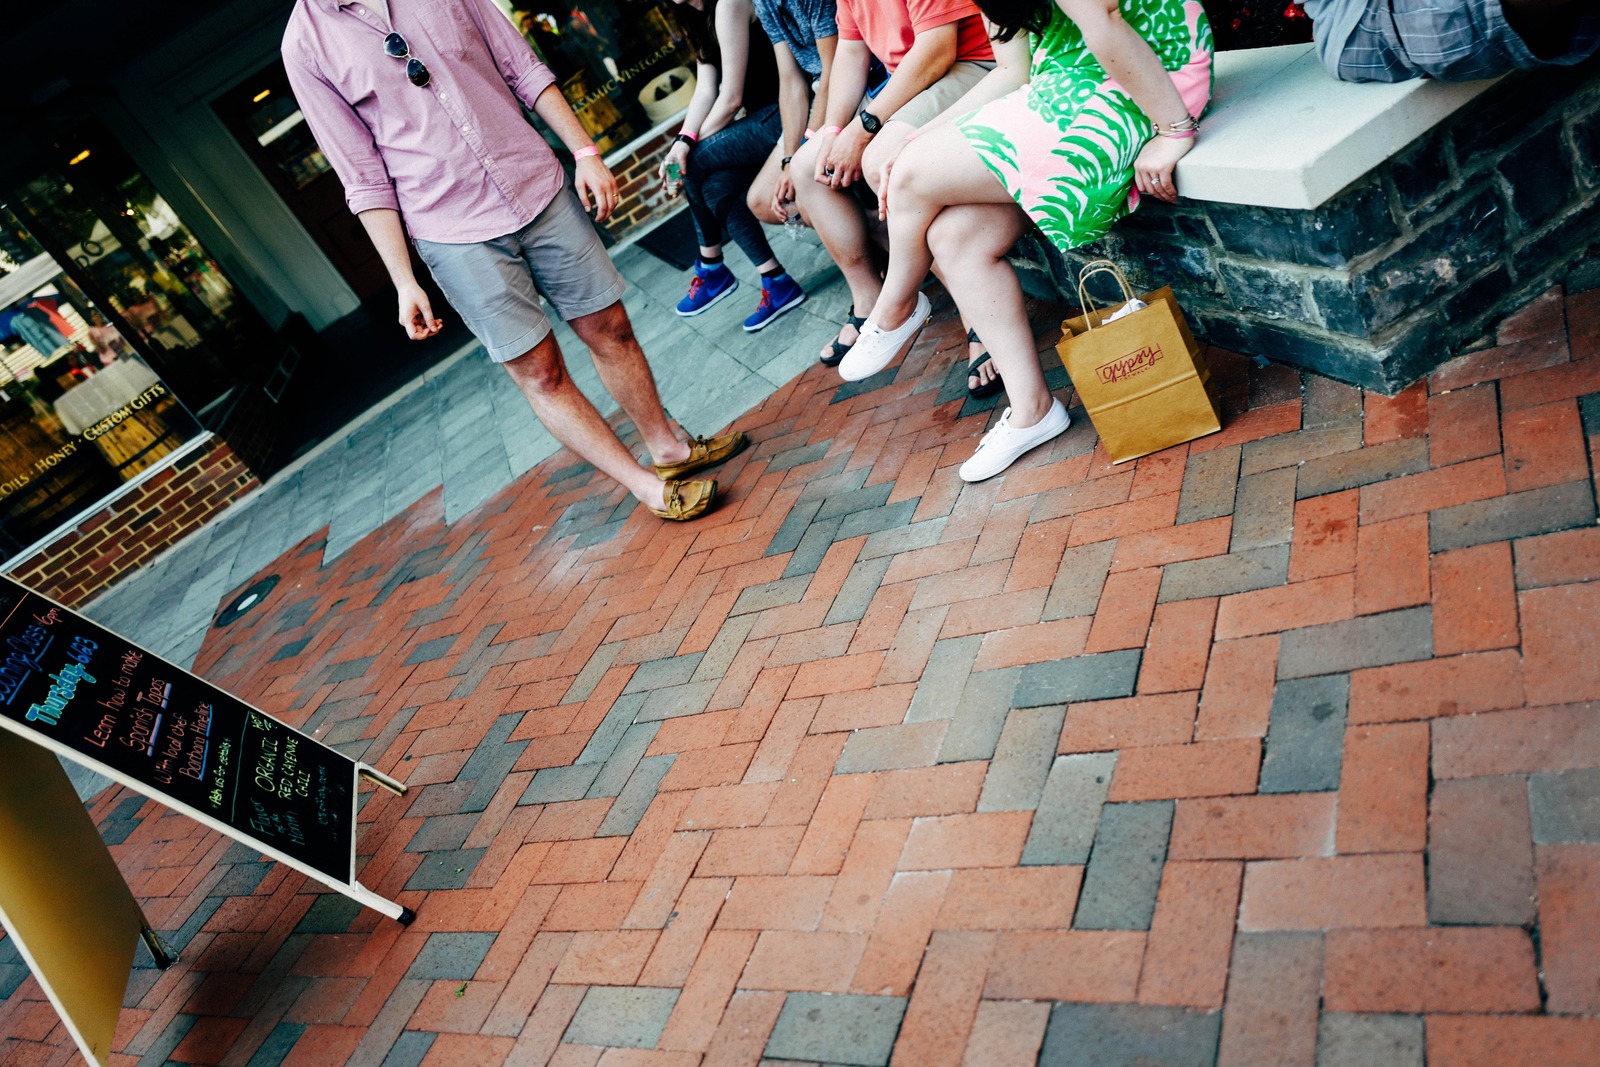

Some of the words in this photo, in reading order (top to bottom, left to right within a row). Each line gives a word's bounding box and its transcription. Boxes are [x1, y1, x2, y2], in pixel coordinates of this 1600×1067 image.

[616, 41, 676, 83] VINEGARS
[1102, 346, 1162, 383] gypsy
[0, 472, 30, 496] OILS
[34, 441, 78, 474] HONEY
[83, 406, 133, 441] CUSTOM
[130, 383, 165, 410] GIFTS
[33, 607, 63, 626] 6pm
[66, 635, 99, 664] 6/23
[121, 649, 143, 676] make
[111, 675, 131, 688] to
[136, 677, 169, 706] Tapas
[96, 688, 127, 712] how
[83, 713, 117, 748] Learn
[119, 705, 155, 752] Spanish
[162, 735, 183, 759] local
[178, 737, 206, 781] Barbara
[281, 735, 299, 776] CAYENNE
[254, 736, 278, 792] ORGANIC
[215, 776, 225, 788] us
[278, 777, 293, 800] RED
[295, 769, 311, 797] CHILI
[250, 797, 275, 836] Flavor
[282, 811, 306, 845] Month
